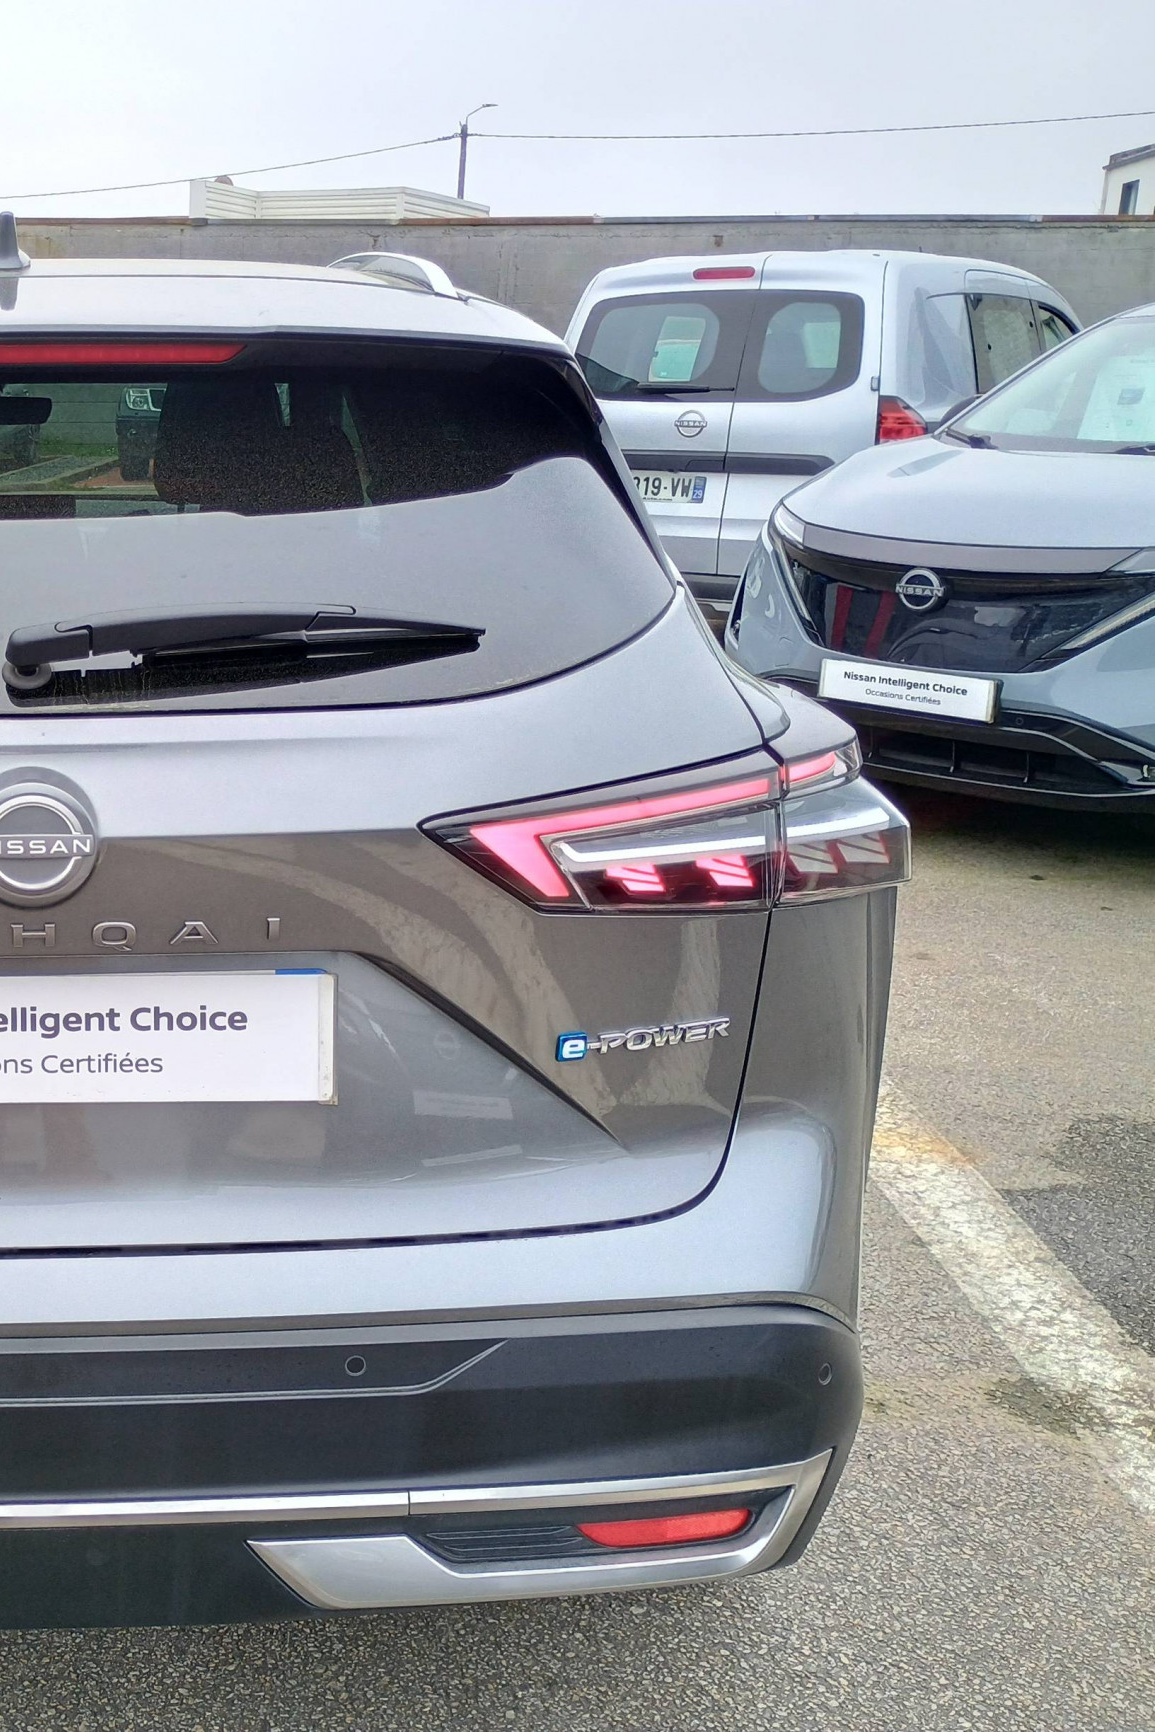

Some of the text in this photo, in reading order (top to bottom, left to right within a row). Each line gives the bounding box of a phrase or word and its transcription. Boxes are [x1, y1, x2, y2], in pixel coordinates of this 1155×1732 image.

[675, 420, 707, 428] NISSAN
[692, 490, 703, 499] 29
[895, 585, 945, 597] NISSAN
[843, 671, 968, 696] Nissan Intelligent Choice
[865, 688, 942, 706] Occasions Certifiées
[130, 1005, 248, 1032] Choice
[558, 1016, 730, 1060] e-POWER
[41, 1052, 164, 1074] Certifiées
